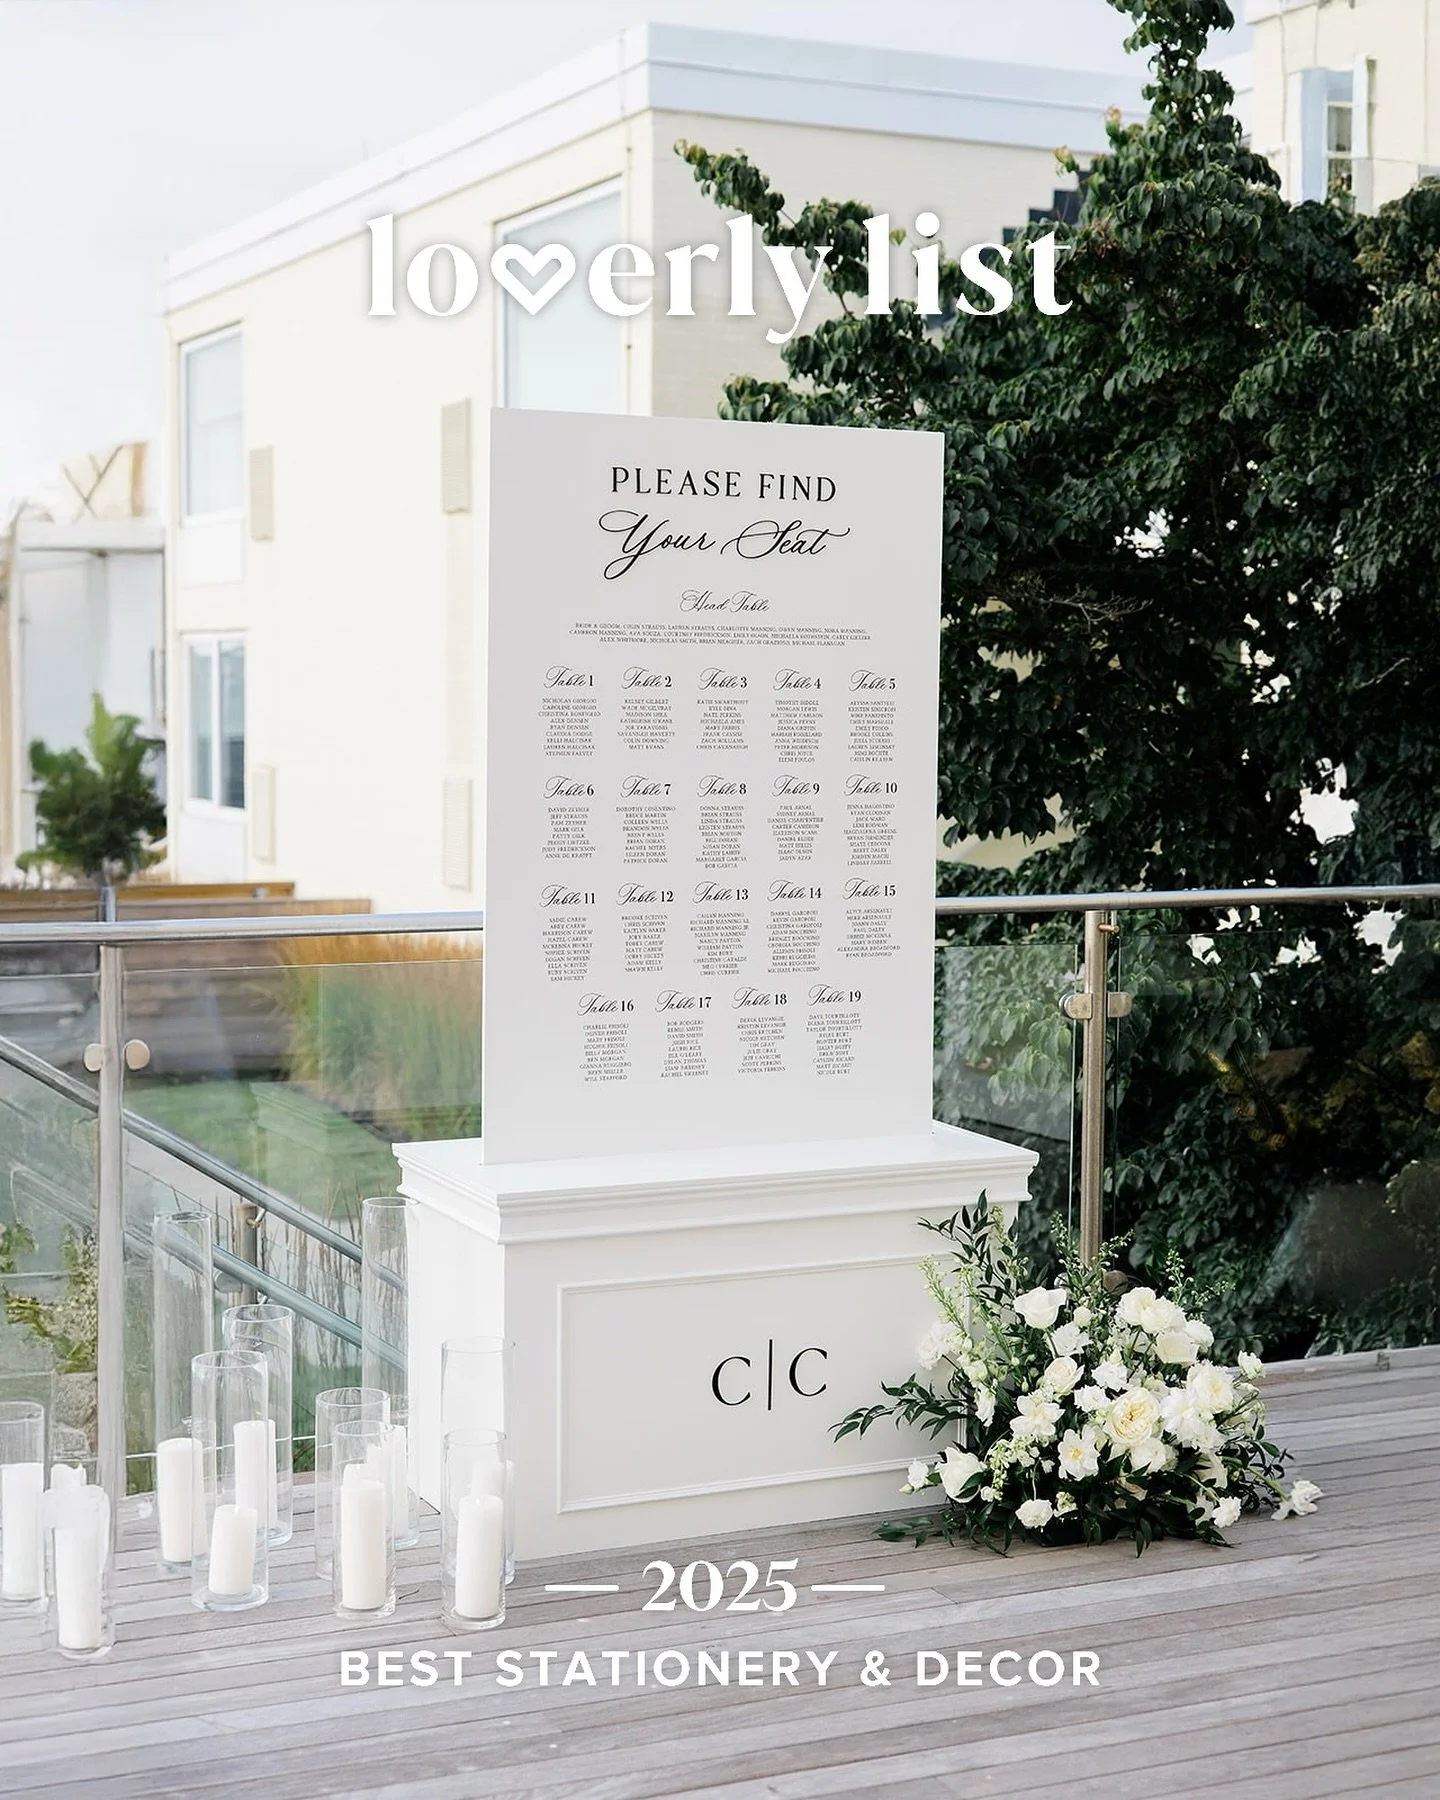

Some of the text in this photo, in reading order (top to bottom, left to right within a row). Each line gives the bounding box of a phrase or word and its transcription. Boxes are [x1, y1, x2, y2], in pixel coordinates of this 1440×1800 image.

[612, 467, 836, 502] PLEASE FIND
[598, 510, 850, 580] Your Seat
[680, 590, 769, 612] Head Table
[544, 666, 592, 688] Table 1
[622, 666, 672, 689] Table 2
[698, 668, 747, 690] Table 3
[773, 668, 821, 691] Table 4
[849, 670, 895, 692] Table 5
[544, 776, 594, 799] Table 6
[620, 776, 671, 798] Table 7
[697, 775, 746, 797] Table 8
[772, 775, 820, 797] Table 9
[844, 774, 897, 796] Table 10
[539, 884, 594, 907] Table 11
[616, 883, 673, 905] Table 12
[692, 881, 748, 904] Table 13
[767, 880, 821, 902] Table 14
[843, 878, 896, 900] Table 15
[577, 993, 634, 1016] Table 16
[655, 990, 711, 1012] Table 17
[732, 987, 787, 1009] Table 18
[807, 984, 861, 1006] Table 19
